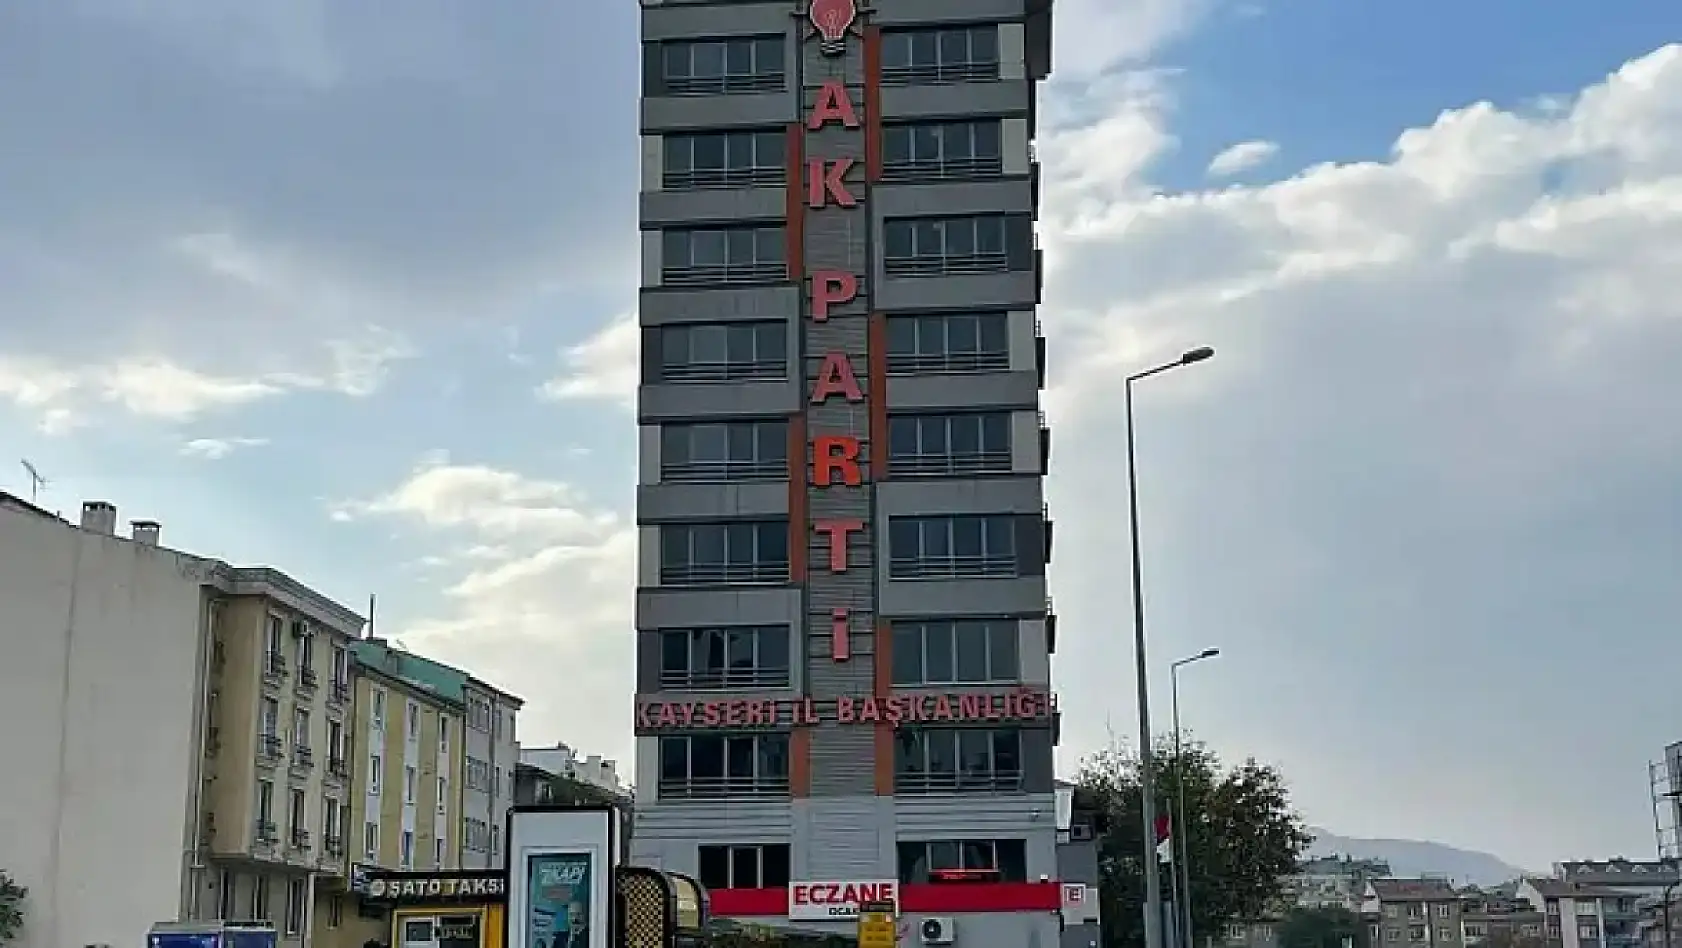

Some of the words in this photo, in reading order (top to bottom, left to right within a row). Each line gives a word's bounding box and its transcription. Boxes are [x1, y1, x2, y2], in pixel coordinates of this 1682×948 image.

[808, 81, 860, 208] AK
[811, 270, 864, 662] PARTİ
[793, 882, 893, 906] ECZANE
